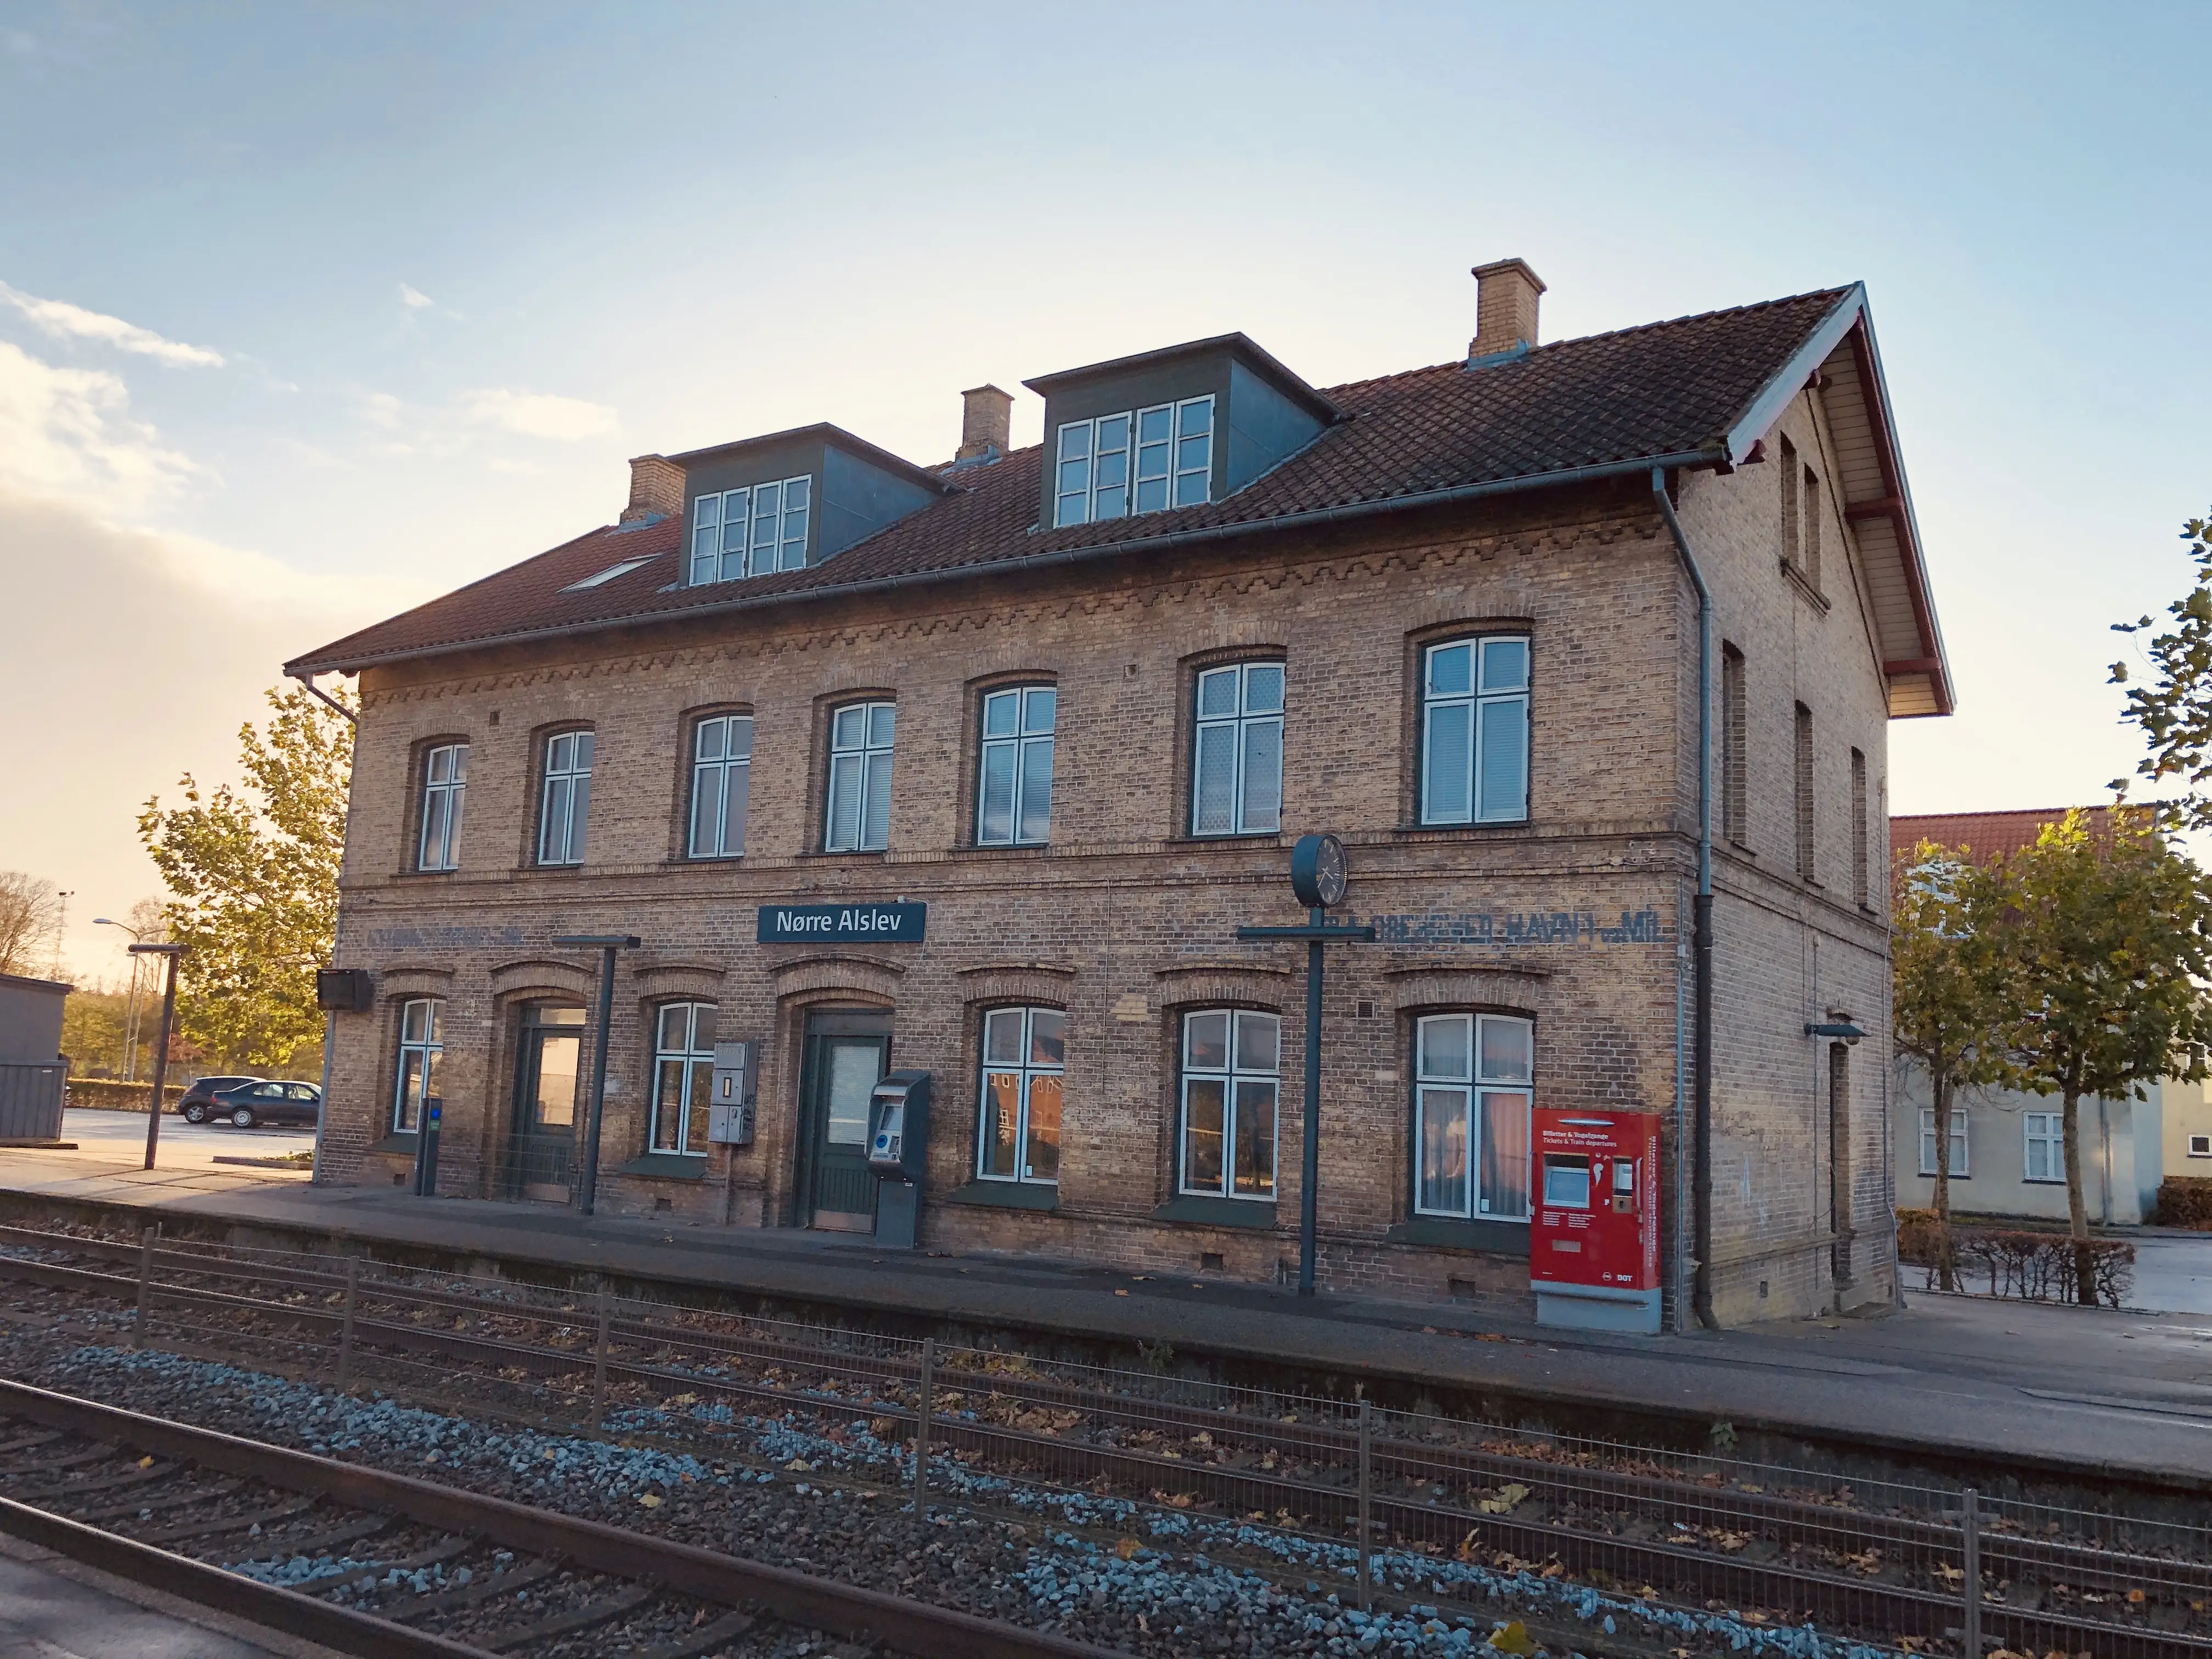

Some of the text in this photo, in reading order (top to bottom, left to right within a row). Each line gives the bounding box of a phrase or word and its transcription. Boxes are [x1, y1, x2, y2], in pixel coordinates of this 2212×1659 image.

[777, 909, 901, 932] Nørre Alslev
[1585, 1139, 1617, 1148] departures
